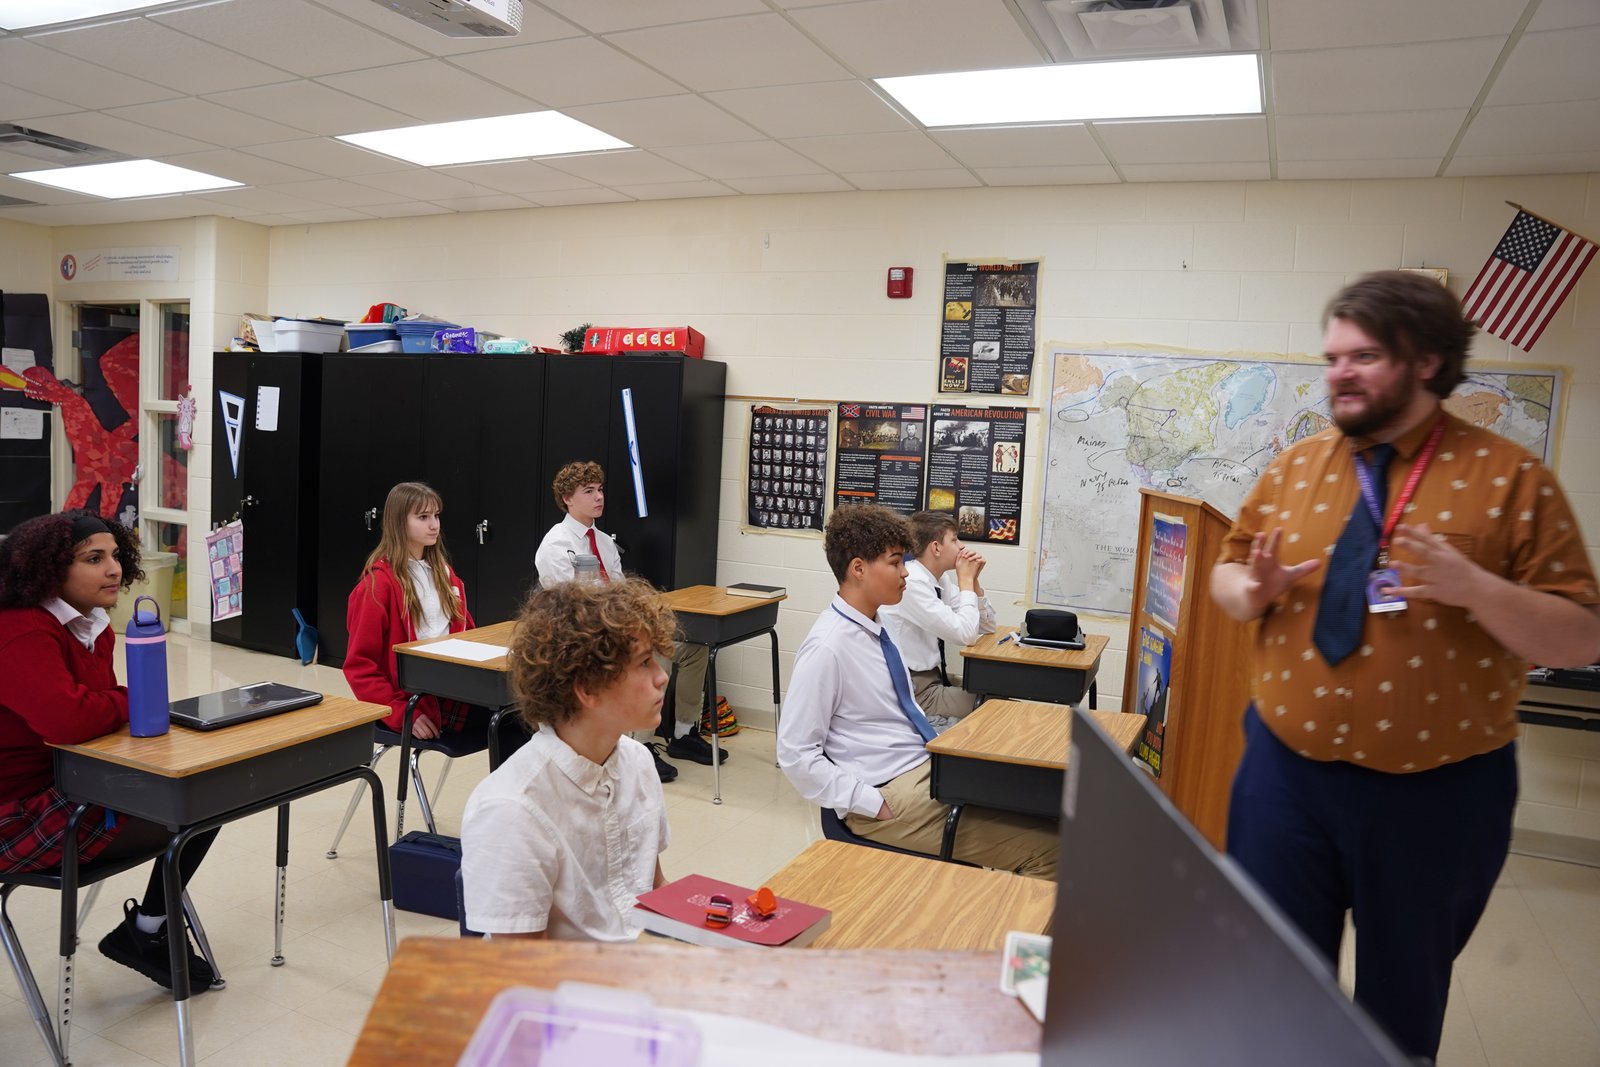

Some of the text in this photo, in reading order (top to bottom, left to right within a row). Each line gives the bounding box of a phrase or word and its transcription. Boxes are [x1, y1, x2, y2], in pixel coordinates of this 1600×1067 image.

[882, 410, 896, 418] WAR
[951, 409, 1024, 419] AMERICAN REVOLUTION
